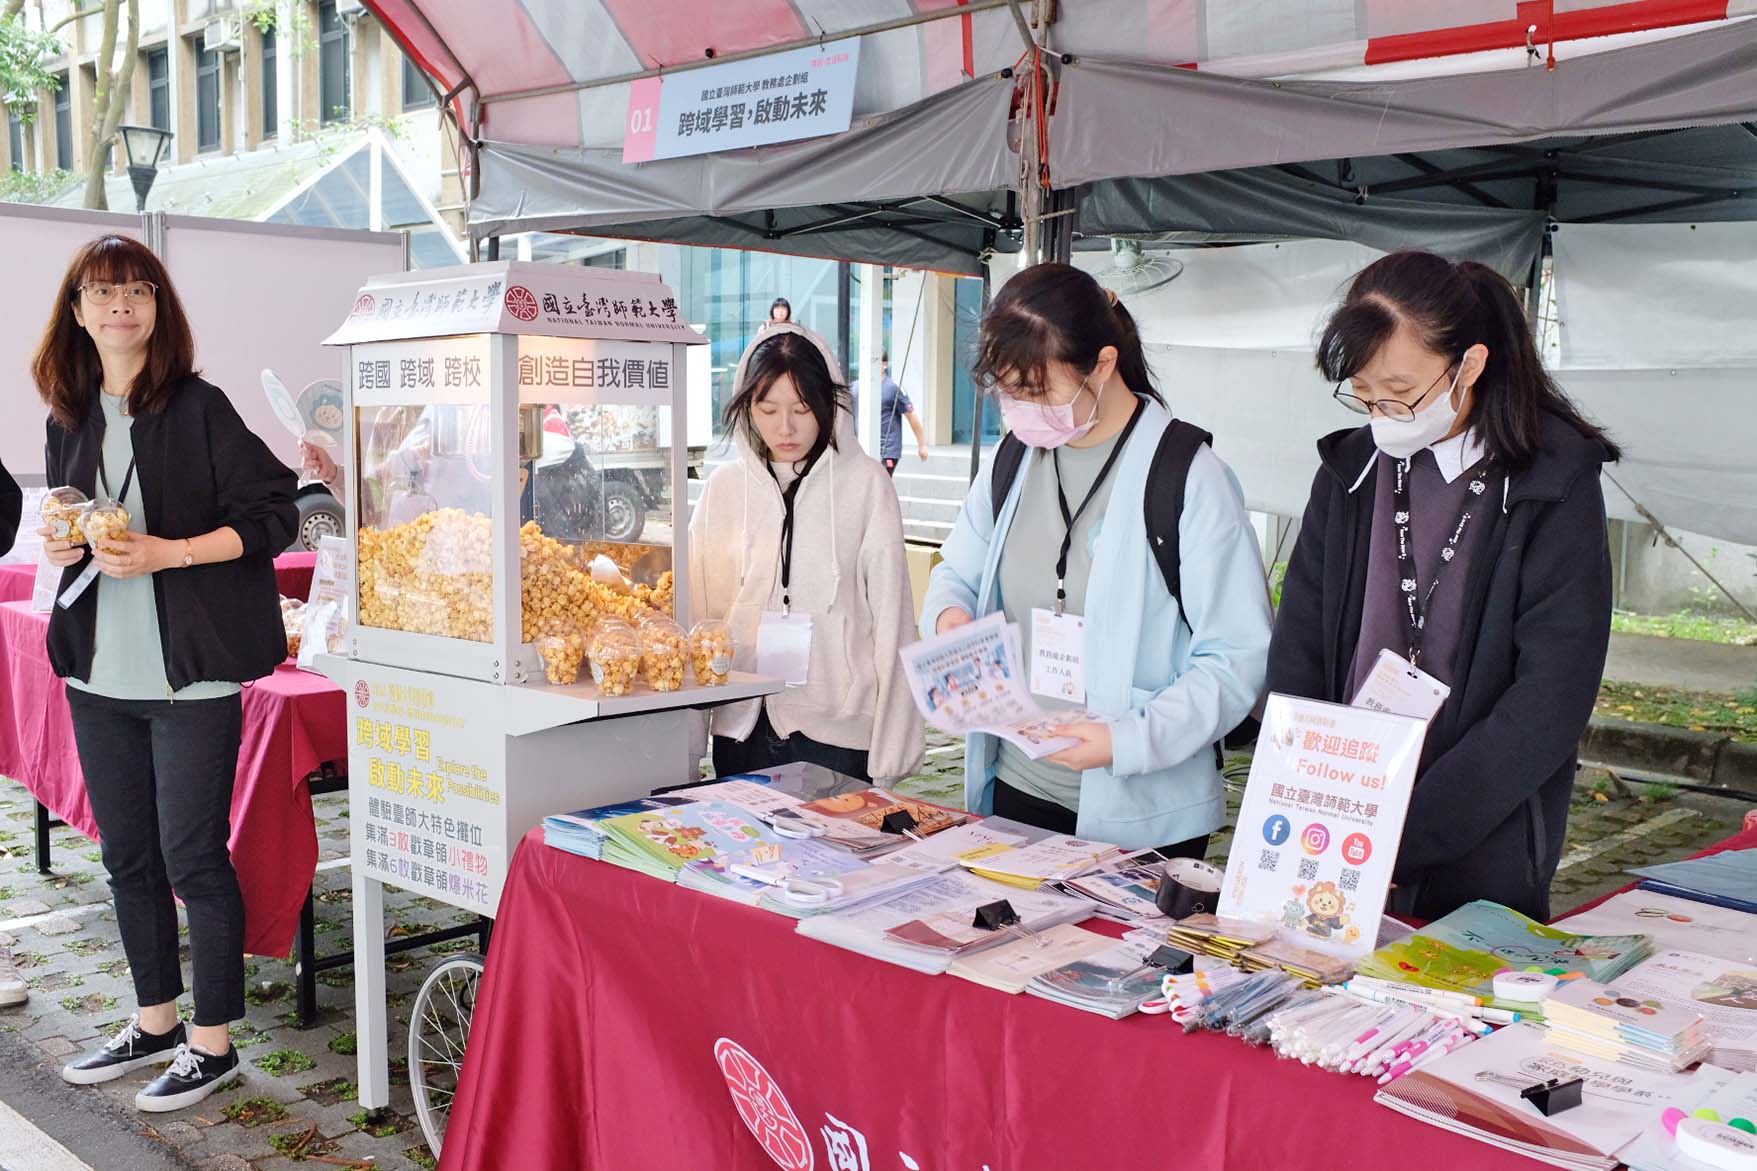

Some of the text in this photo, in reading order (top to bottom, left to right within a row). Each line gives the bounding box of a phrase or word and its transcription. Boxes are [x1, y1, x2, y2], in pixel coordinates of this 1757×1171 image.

[700, 71, 809, 102] 國立臺灣師範大學 教務處企劃組
[630, 108, 652, 133] 01
[542, 293, 678, 323] 國立臺灣師範大學
[547, 317, 686, 330] NATIONAL TAIWAN NORMAL UNIVERSITY
[358, 355, 481, 390] 跨國 跨域 跨校
[518, 354, 669, 390] 創造自我價值
[356, 716, 431, 761] 跨域學習
[1302, 730, 1380, 765] 歡迎追蹤
[369, 757, 445, 804] 啟動未來
[1296, 758, 1387, 791] Follow us!
[1271, 783, 1379, 818] 國立臺灣師範大學
[368, 797, 482, 847] 體驗臺師大特色攤位
[1341, 814, 1374, 827] University
